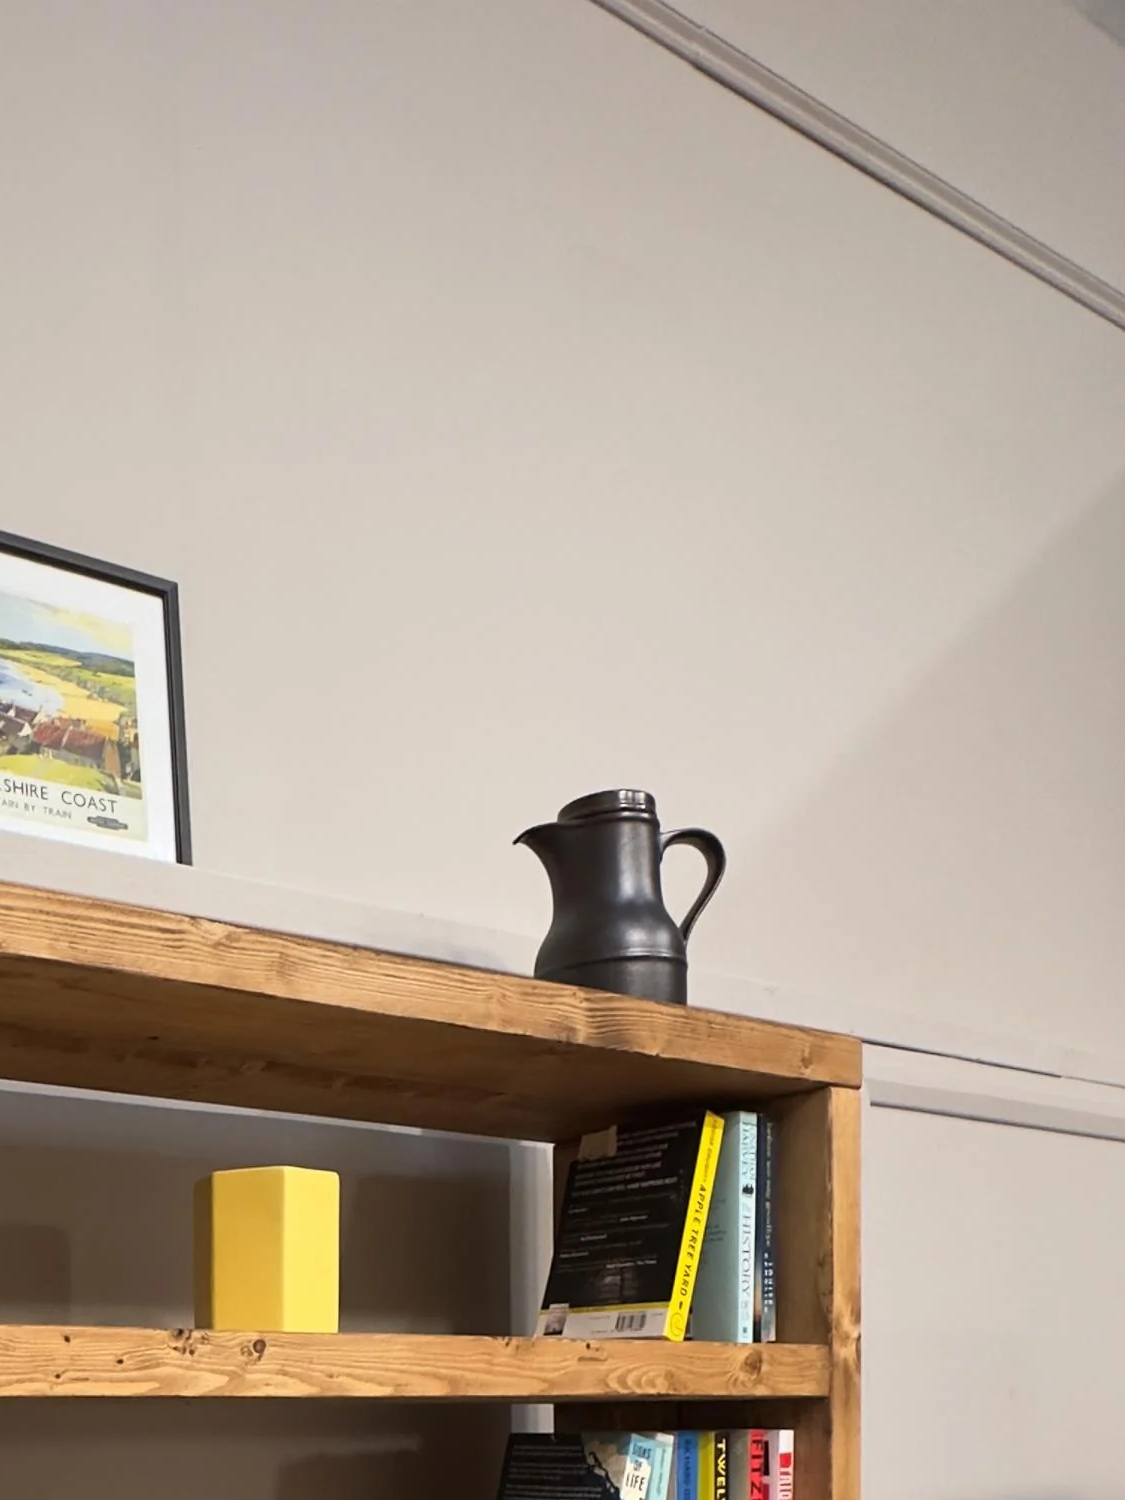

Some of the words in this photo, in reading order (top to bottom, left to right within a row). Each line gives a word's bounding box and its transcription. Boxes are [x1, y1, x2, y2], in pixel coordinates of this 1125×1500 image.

[24, 802, 37, 814] BY
[42, 805, 73, 820] TRAIN
[60, 790, 119, 814] COAST
[693, 1184, 707, 1224] APPLE
[686, 1229, 699, 1260] TREE
[742, 1215, 751, 1296] HISTORY
[679, 1263, 692, 1297] YARD
[625, 1472, 646, 1492] LIFE
